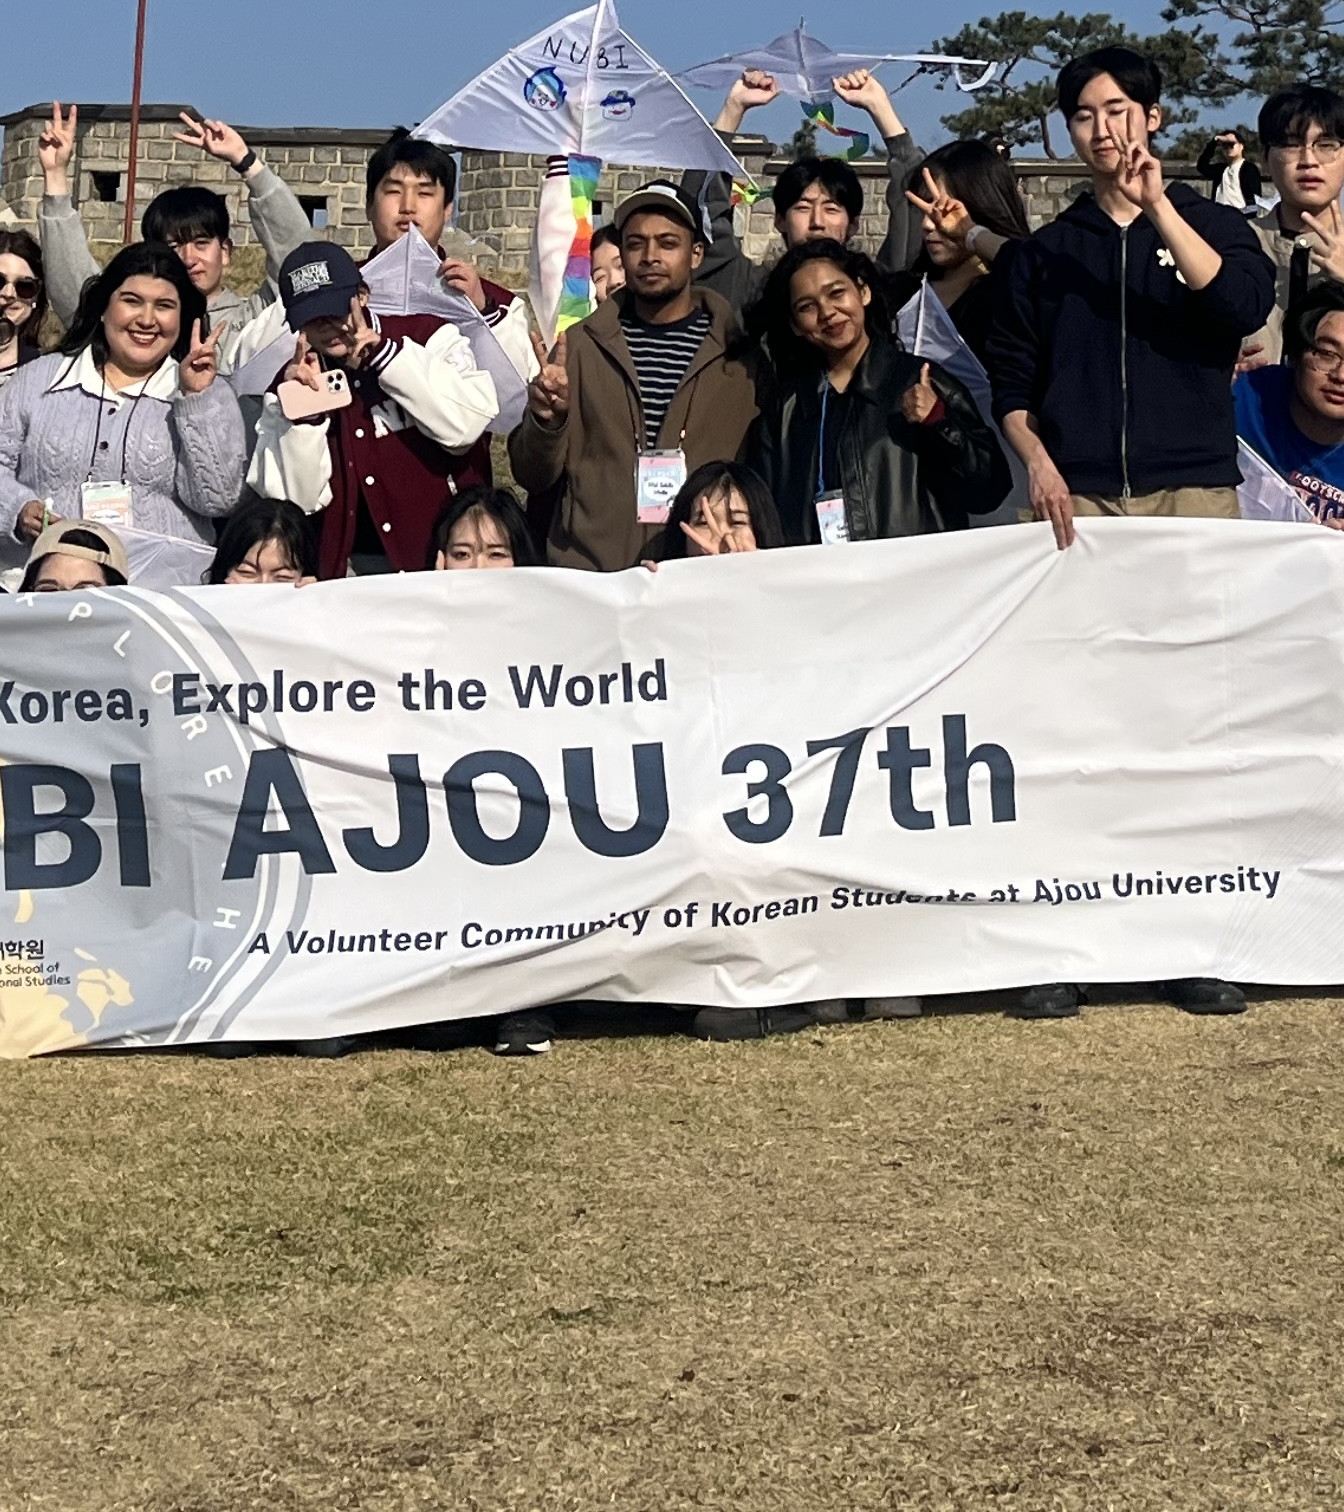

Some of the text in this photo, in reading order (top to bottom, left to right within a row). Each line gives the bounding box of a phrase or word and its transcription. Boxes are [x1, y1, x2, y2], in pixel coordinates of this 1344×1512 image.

[542, 36, 628, 69] NUBI
[172, 669, 376, 725] Explore
[398, 669, 487, 711] the
[508, 658, 668, 708] World
[222, 742, 670, 880] AJOU
[721, 714, 1016, 844] 37th
[248, 931, 271, 955] A
[286, 929, 448, 954] Volunteer
[663, 902, 698, 928] of
[711, 893, 818, 928] Korean
[1032, 878, 1102, 905] Ajou
[1112, 866, 1280, 899] University
[5, 963, 43, 974] School
[46, 961, 60, 973] of
[25, 974, 71, 986] Studies
